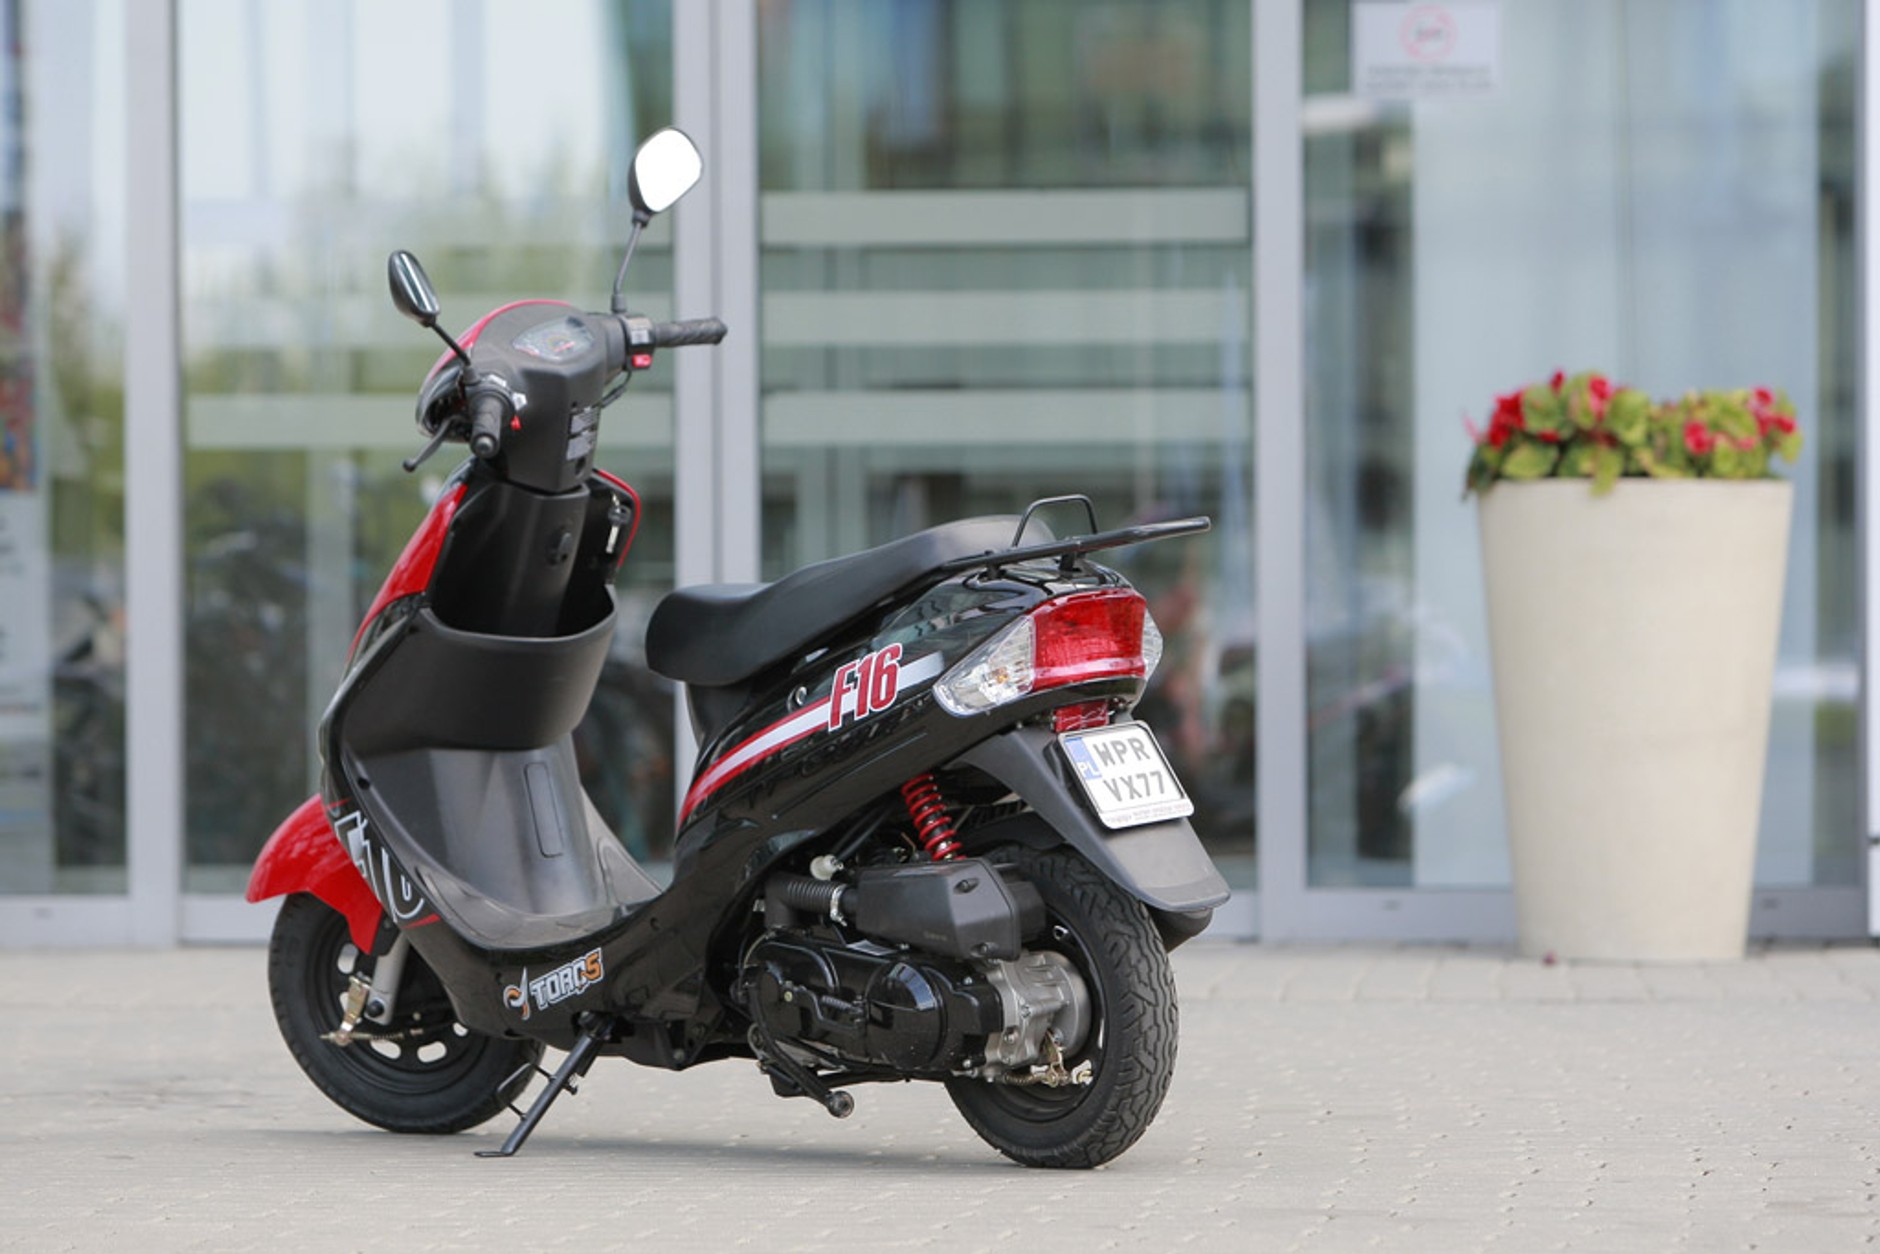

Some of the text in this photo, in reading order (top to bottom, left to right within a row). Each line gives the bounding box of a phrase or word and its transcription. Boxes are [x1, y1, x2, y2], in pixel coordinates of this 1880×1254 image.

[828, 642, 903, 733] F16
[1093, 737, 1150, 767] WPR
[1077, 761, 1101, 778] PL
[1103, 770, 1165, 802] VX77
